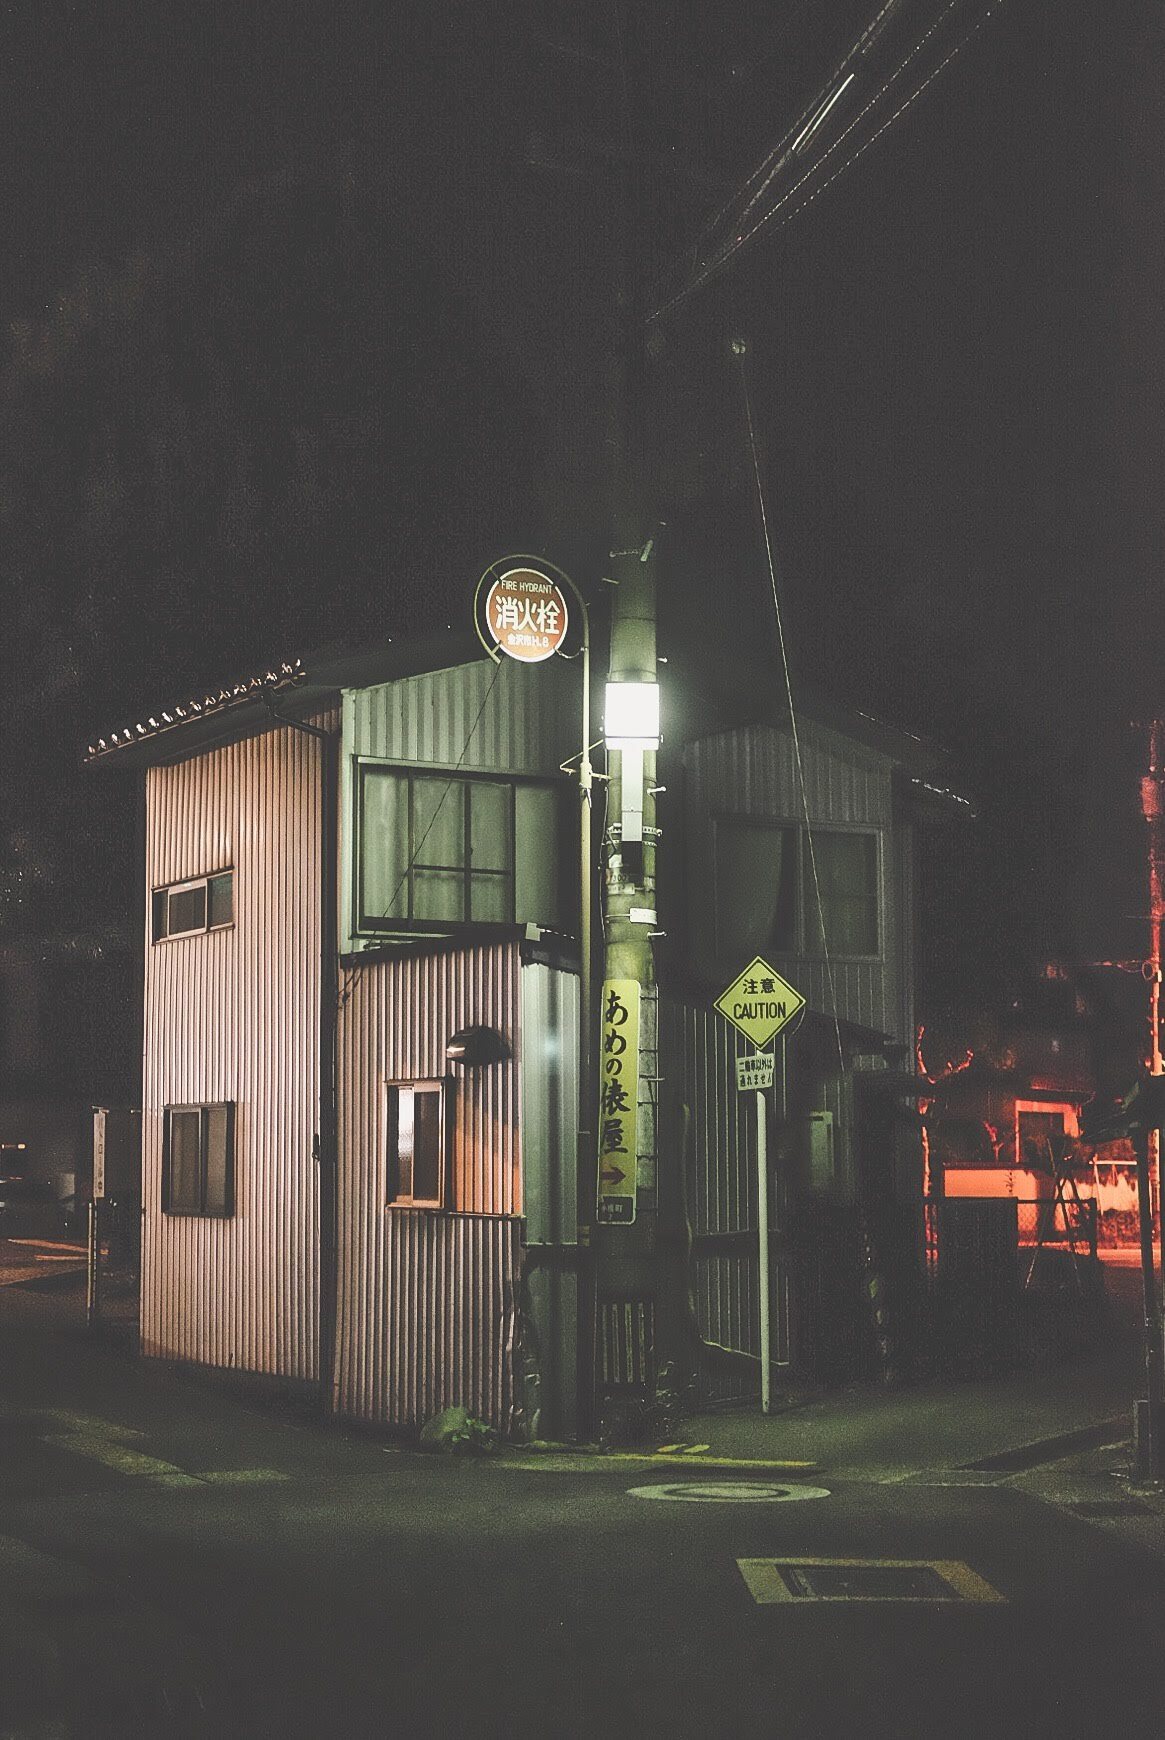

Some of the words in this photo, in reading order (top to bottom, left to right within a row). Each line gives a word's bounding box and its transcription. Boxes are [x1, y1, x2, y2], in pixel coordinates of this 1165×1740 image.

[501, 580, 518, 591] FIRE
[519, 582, 552, 594] HYDRANT
[495, 595, 560, 635] 消火栓
[742, 977, 776, 995] 注意
[733, 1002, 787, 1020] CAUTION
[602, 990, 632, 1155] あめの俵屋
